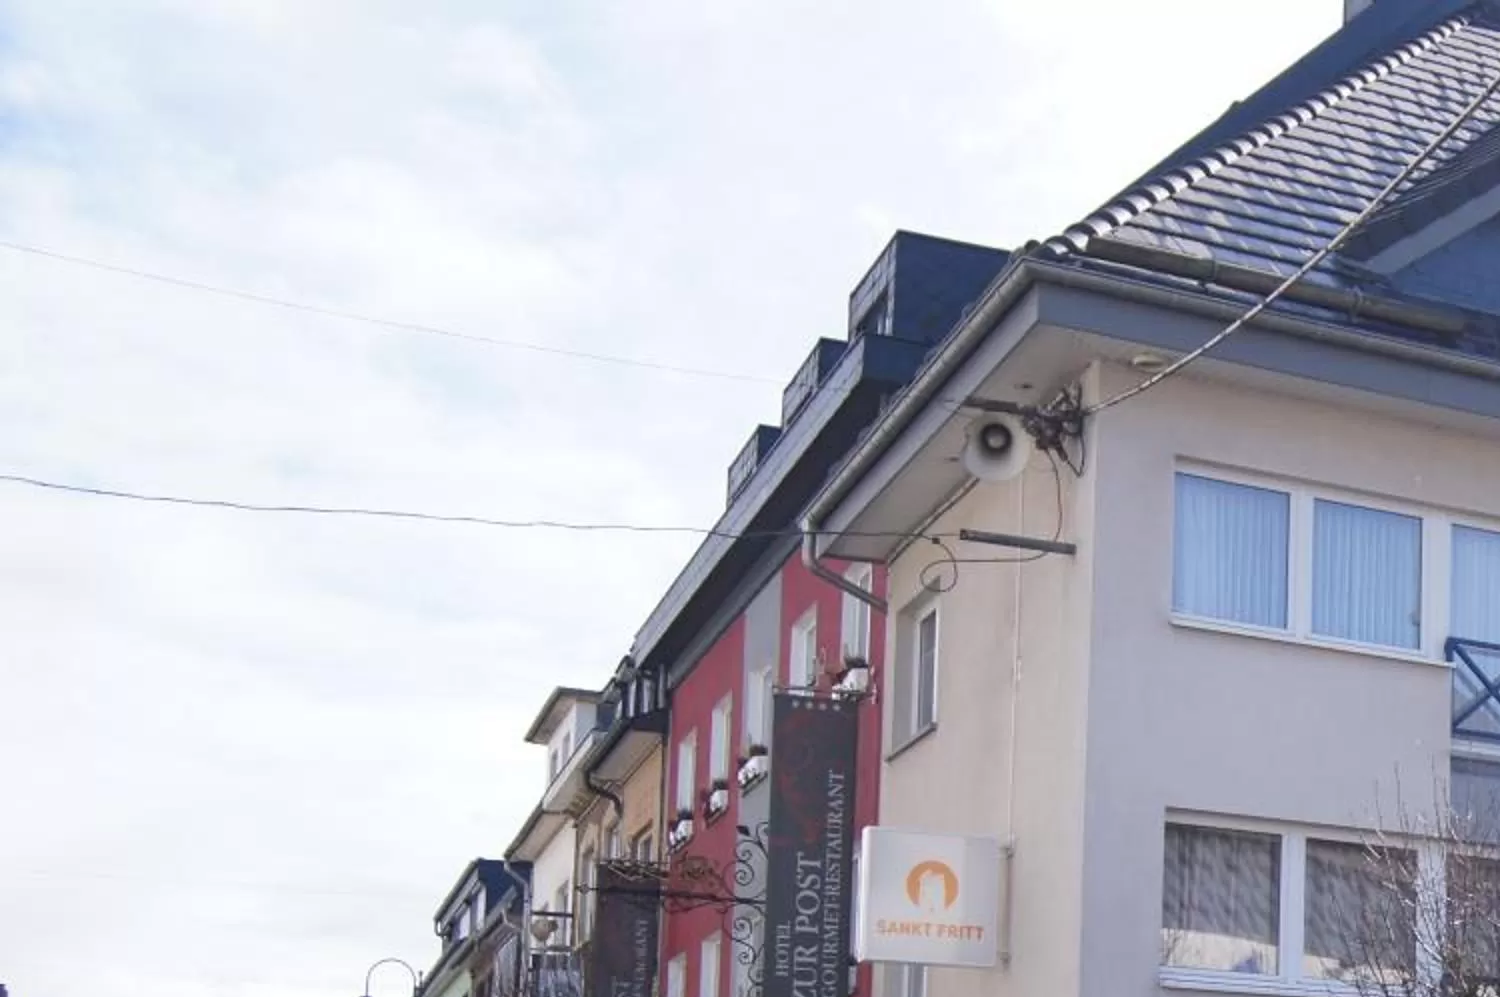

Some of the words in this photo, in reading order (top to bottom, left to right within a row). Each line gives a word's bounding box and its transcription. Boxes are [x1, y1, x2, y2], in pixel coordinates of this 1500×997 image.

[795, 851, 822, 936] POST
[775, 920, 790, 978] HOTEL
[876, 918, 931, 938] SANKT
[936, 923, 985, 943] FRITT
